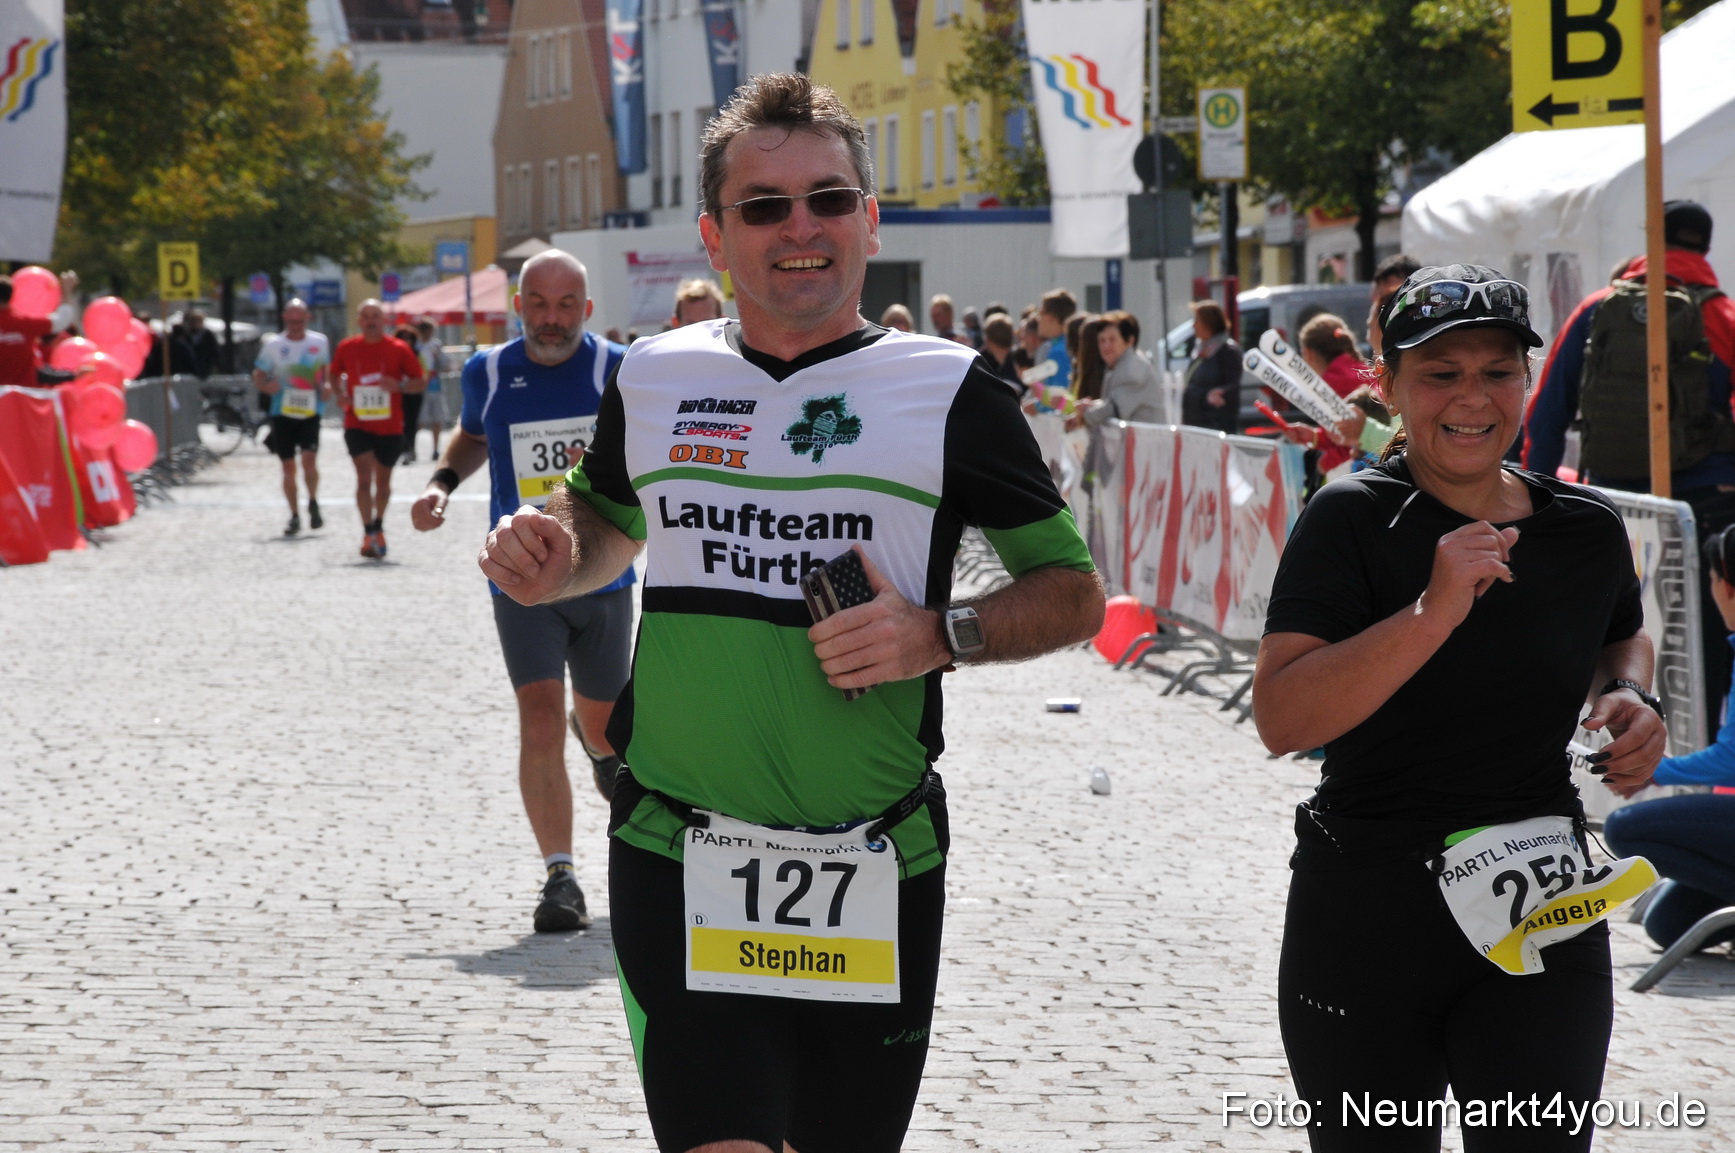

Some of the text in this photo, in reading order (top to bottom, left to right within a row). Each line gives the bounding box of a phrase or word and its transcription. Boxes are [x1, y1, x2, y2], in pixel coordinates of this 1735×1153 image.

[1551, 0, 1623, 81] B
[1213, 102, 1231, 119] H
[169, 260, 190, 288] D
[1262, 366, 1289, 394] BMW
[715, 399, 757, 415] RACER
[513, 426, 586, 440] PARTL Neumarkt
[781, 433, 858, 442] Laufteam Fürth
[669, 444, 749, 469] OBI
[658, 495, 873, 541] Laufteam
[691, 828, 862, 855] PARTL Neumarkt
[1441, 831, 1569, 887] PARTL Neumarkt
[731, 858, 858, 928] 127
[695, 914, 704, 925] D
[1523, 898, 1608, 935] Angela
[739, 940, 846, 976] Stephan
[1300, 994, 1346, 1016] FALKE
